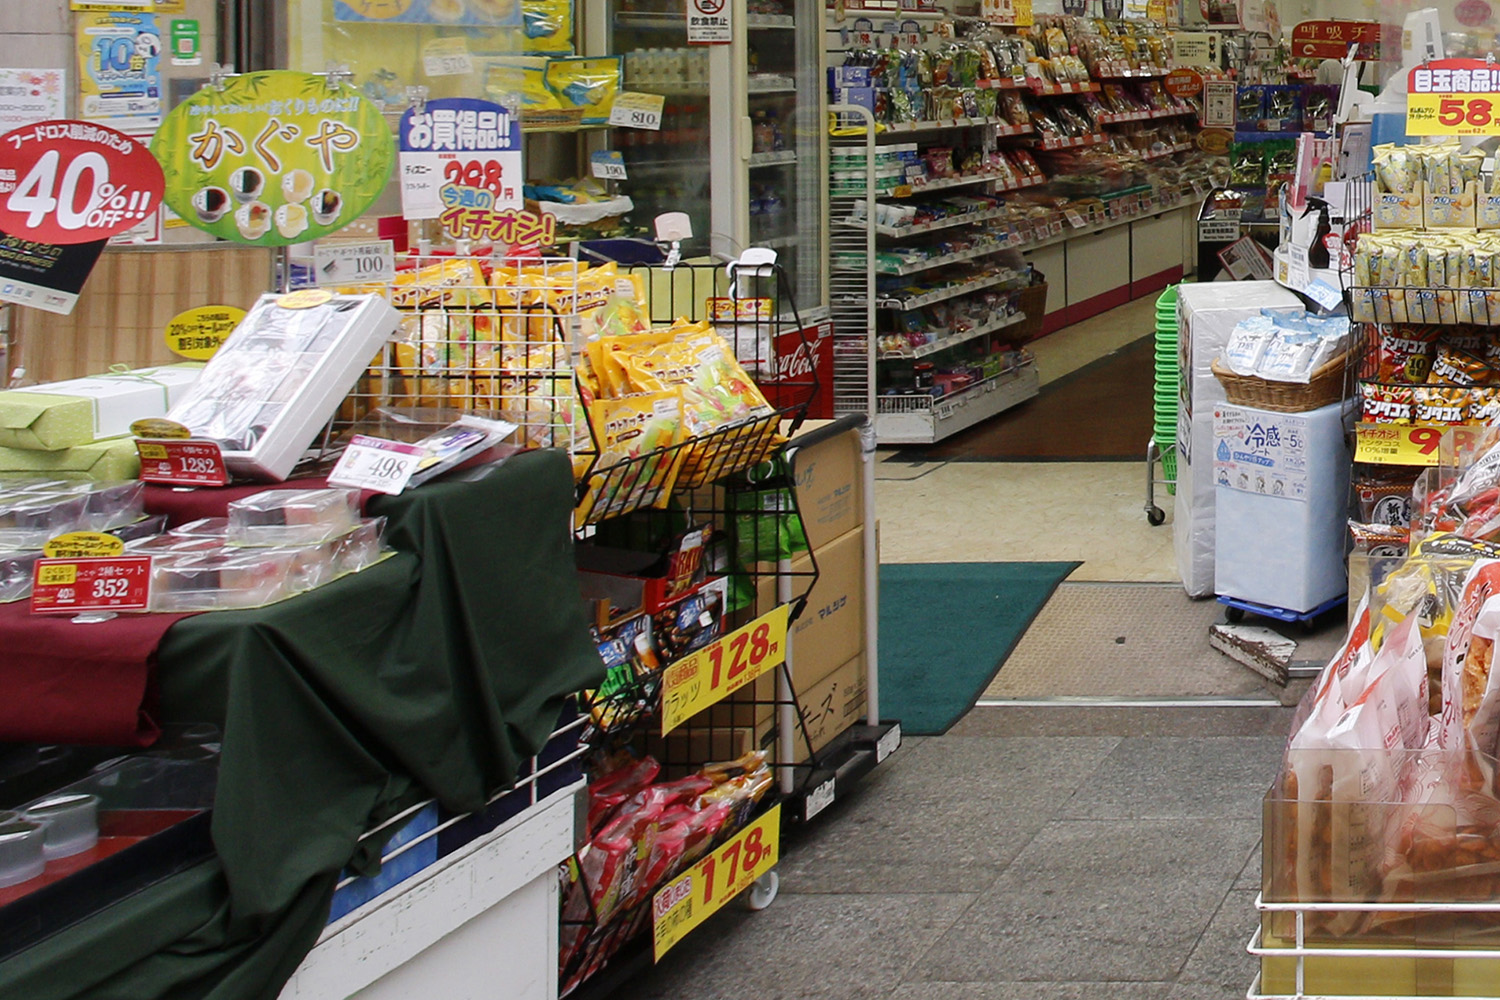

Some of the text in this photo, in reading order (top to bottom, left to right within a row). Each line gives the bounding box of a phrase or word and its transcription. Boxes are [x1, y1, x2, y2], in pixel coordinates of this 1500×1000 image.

[690, 16, 728, 27] 飲食禁止
[1438, 99, 1494, 127] 58
[7, 123, 134, 156] フードロス削減のため
[408, 109, 512, 151] お買得品!!
[188, 118, 360, 174] かぐや
[440, 184, 494, 209] 今週の
[504, 187, 514, 201] 円
[440, 207, 556, 247] イチオシ!
[1363, 399, 1413, 419] ドンタコス
[1416, 403, 1463, 422] ドンタコス
[1245, 422, 1281, 448] 冷感
[180, 457, 216, 473] 1282
[369, 456, 410, 481] 498
[92, 578, 129, 598] 352
[708, 622, 778, 691] 128 円
[701, 826, 763, 906] 178
[762, 843, 772, 860] 円
